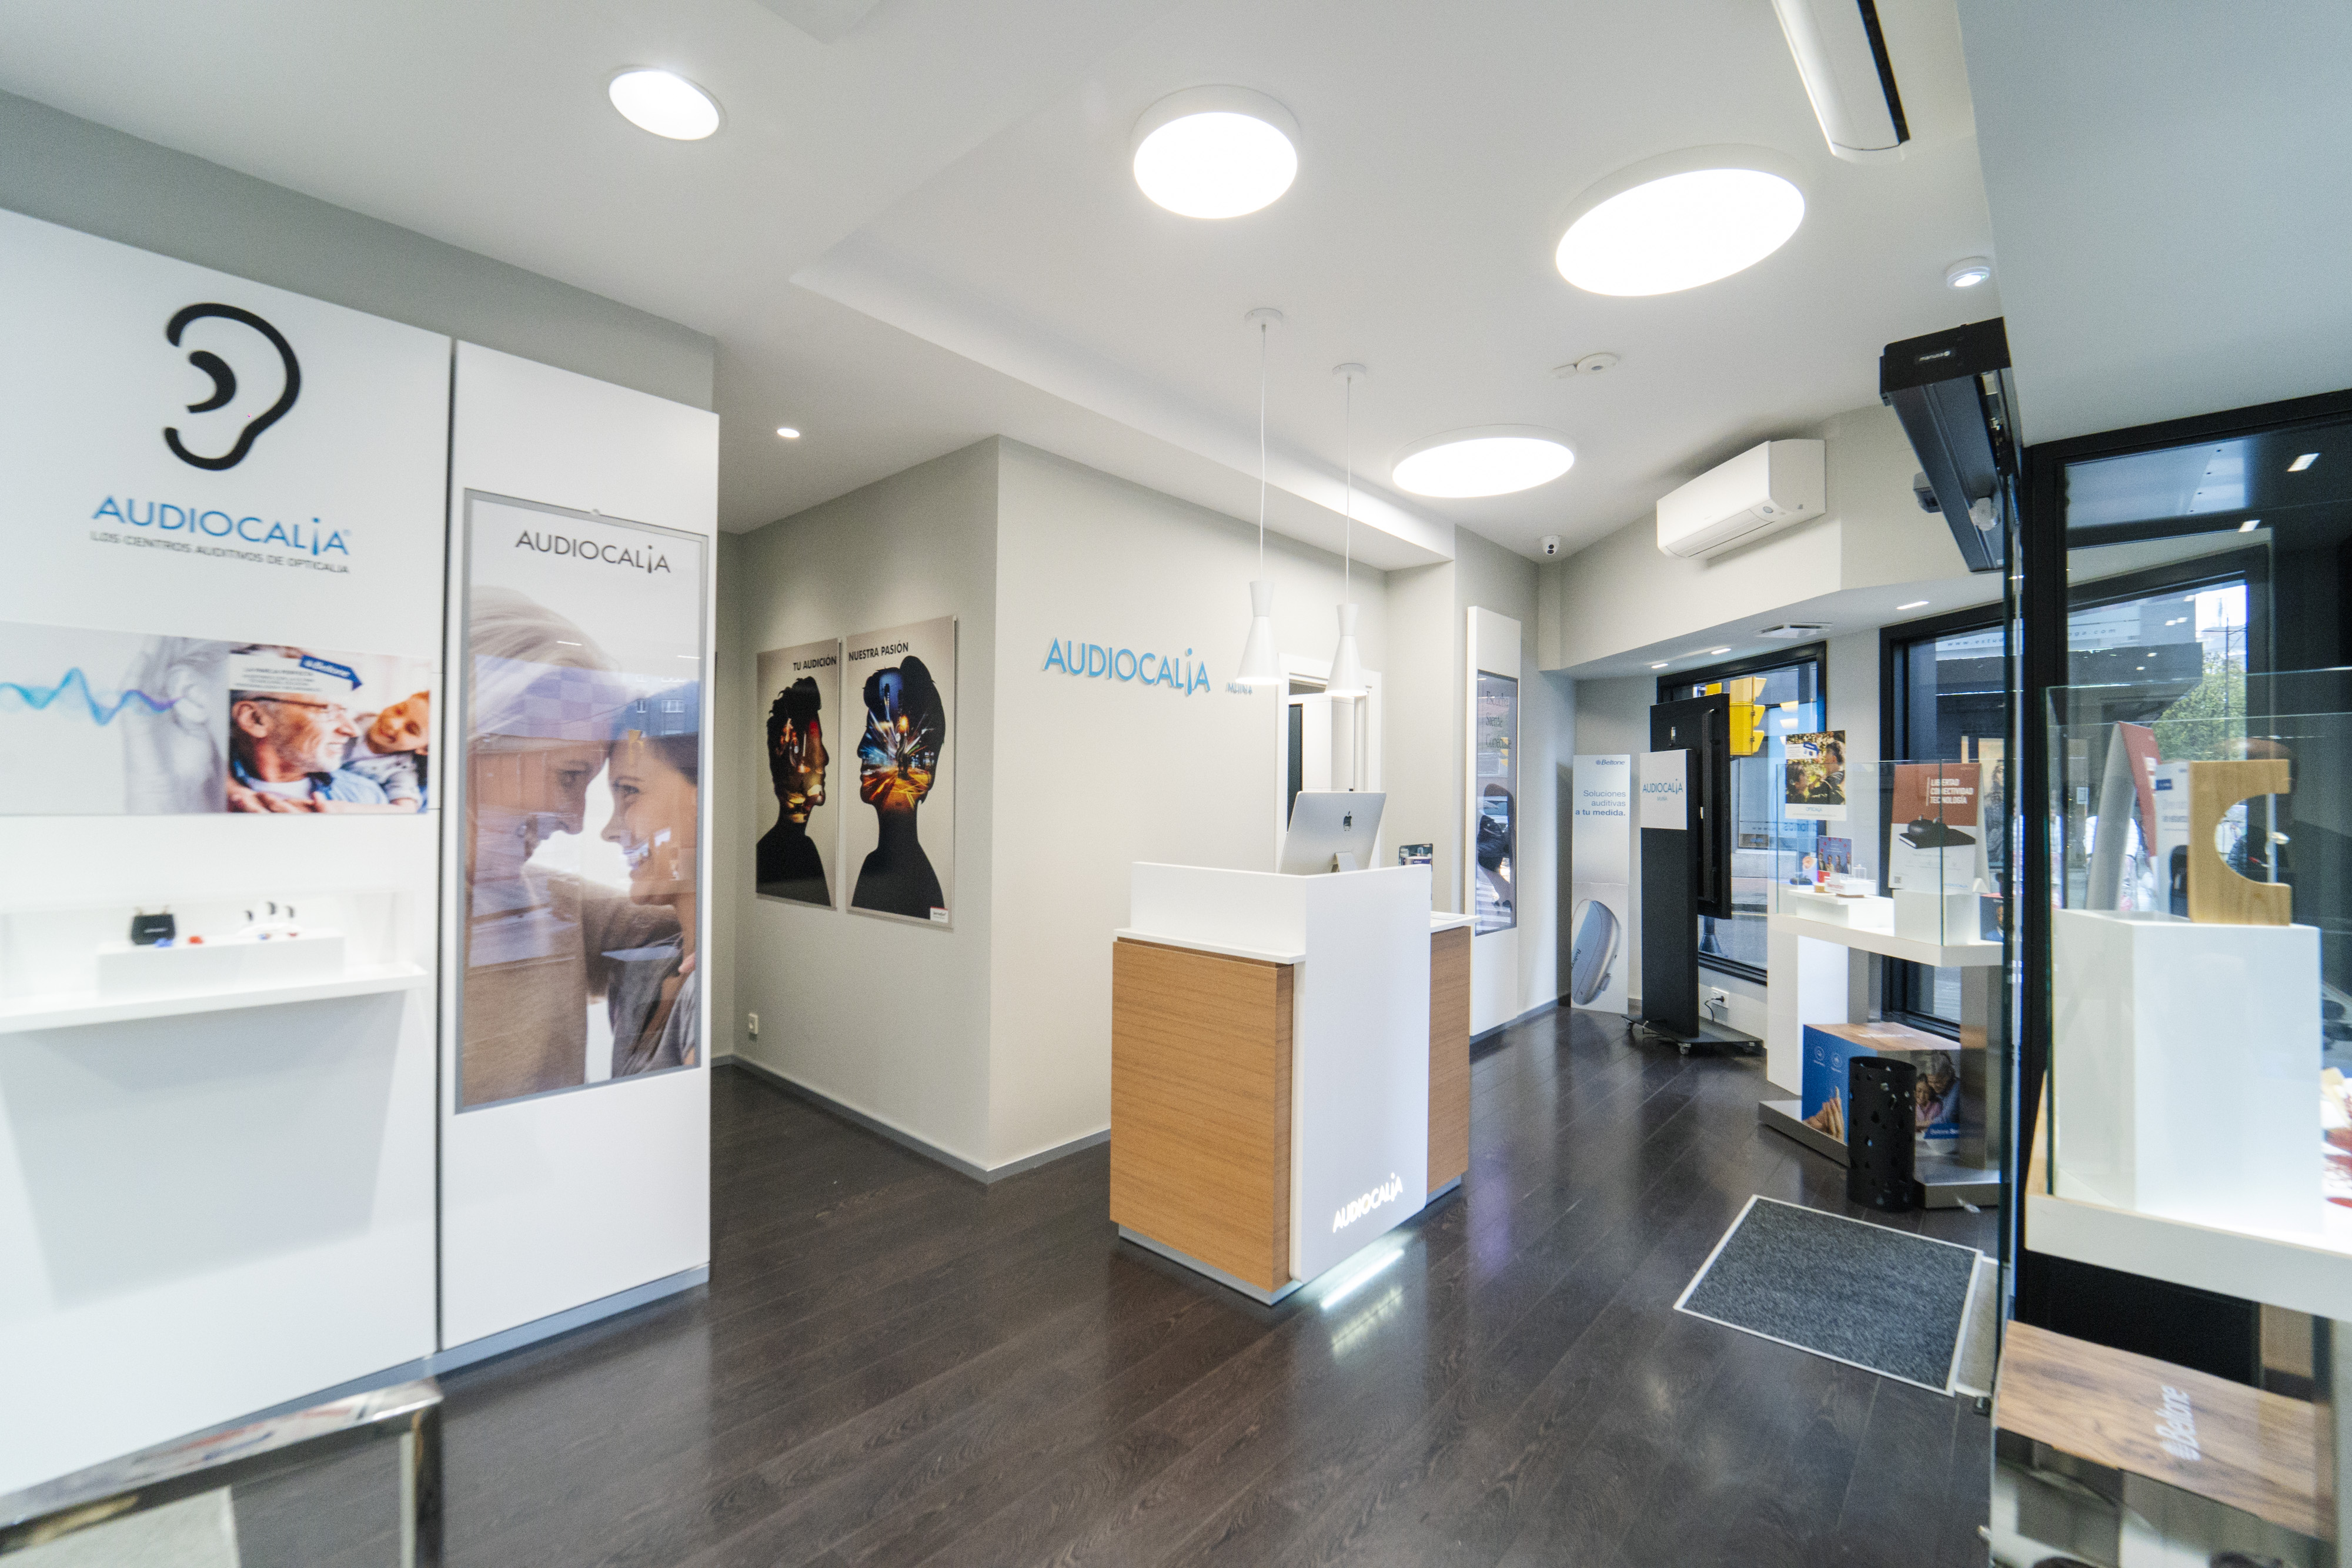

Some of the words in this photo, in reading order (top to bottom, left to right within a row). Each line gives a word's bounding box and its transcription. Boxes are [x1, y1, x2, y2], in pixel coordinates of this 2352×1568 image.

[90, 531, 121, 543] LOS
[124, 536, 192, 553] CENTROS
[195, 545, 265, 563] AUDITIVOS
[267, 555, 285, 566] DE
[286, 557, 350, 574] OPTICALIA
[848, 647, 879, 661] NUESTRA
[881, 640, 908, 656] PASIÓN
[793, 662, 801, 671] TU
[803, 654, 837, 670] AUDICIÓN
